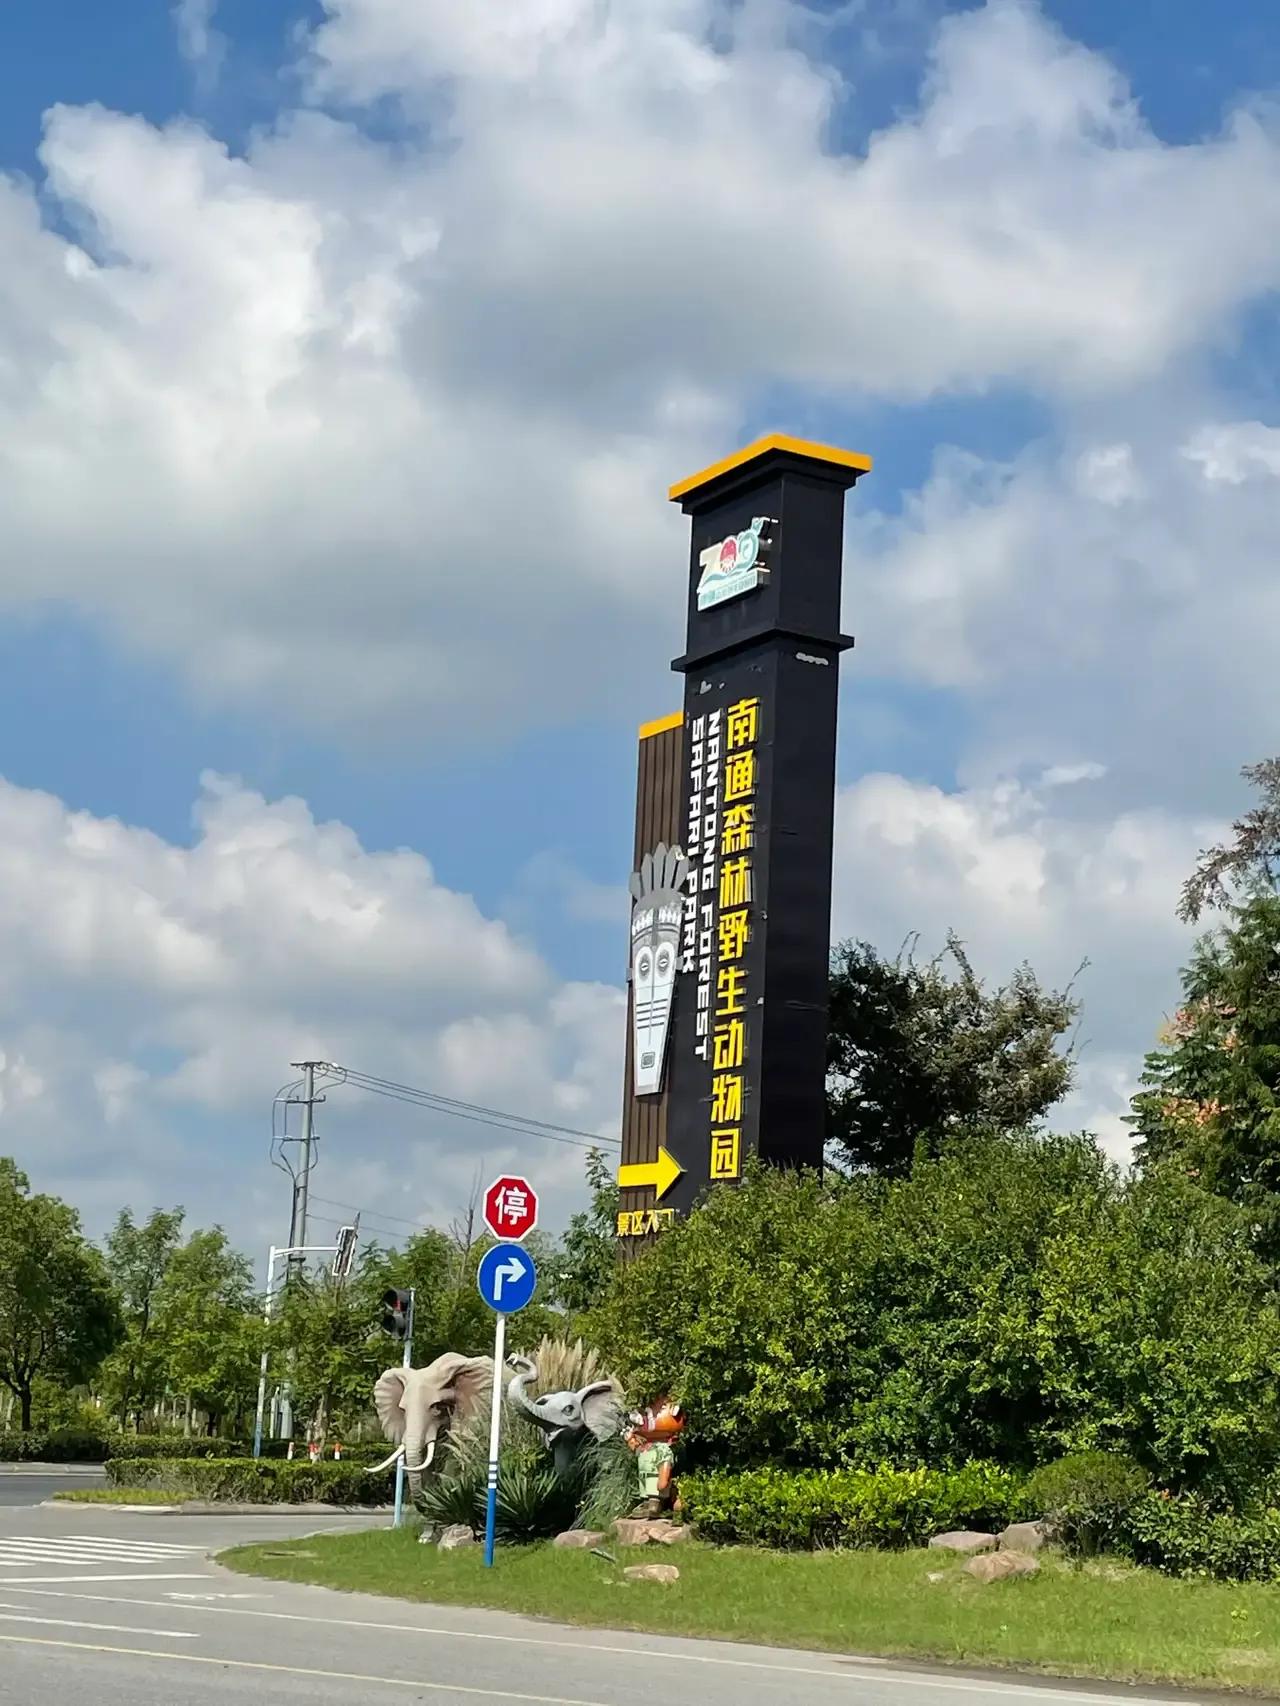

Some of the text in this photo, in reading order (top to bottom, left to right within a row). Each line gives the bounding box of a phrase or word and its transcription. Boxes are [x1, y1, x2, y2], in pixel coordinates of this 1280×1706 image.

[682, 715, 705, 973] SAFARI PARK
[695, 709, 721, 1061] NANTONG FOREST
[710, 697, 759, 1180] 南通森林野生动物园
[495, 1186, 528, 1225] 停
